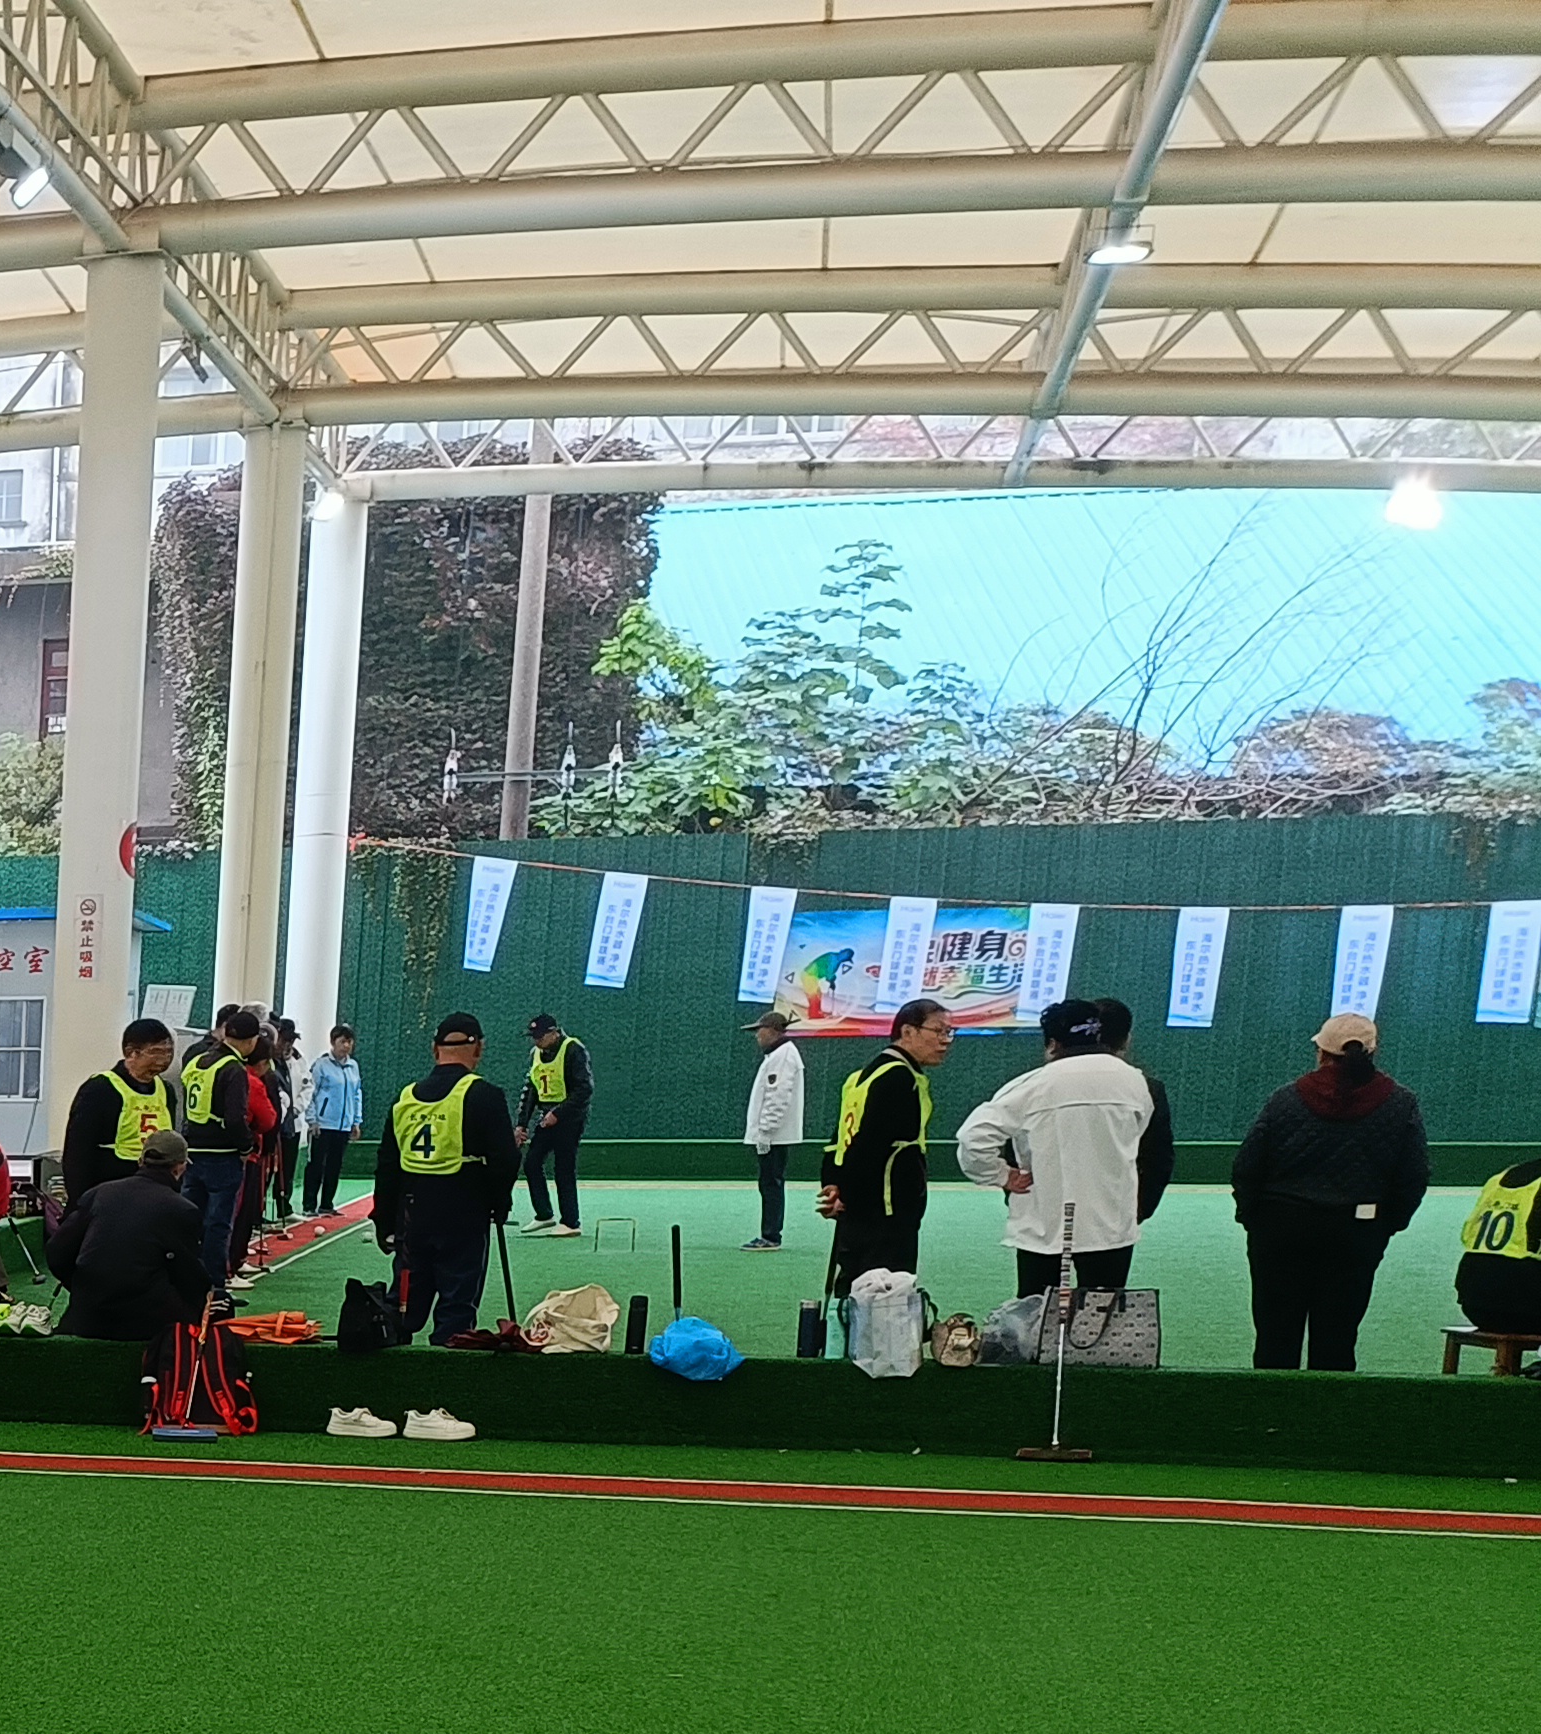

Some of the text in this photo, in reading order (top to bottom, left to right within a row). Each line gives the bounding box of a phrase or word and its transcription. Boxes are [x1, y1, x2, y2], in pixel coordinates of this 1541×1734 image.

[78, 919, 94, 979] 禁止吸烟
[188, 1083, 201, 1109] 6
[539, 1074, 548, 1094] 1
[410, 1123, 435, 1159] 4
[1473, 1210, 1515, 1251] 10
